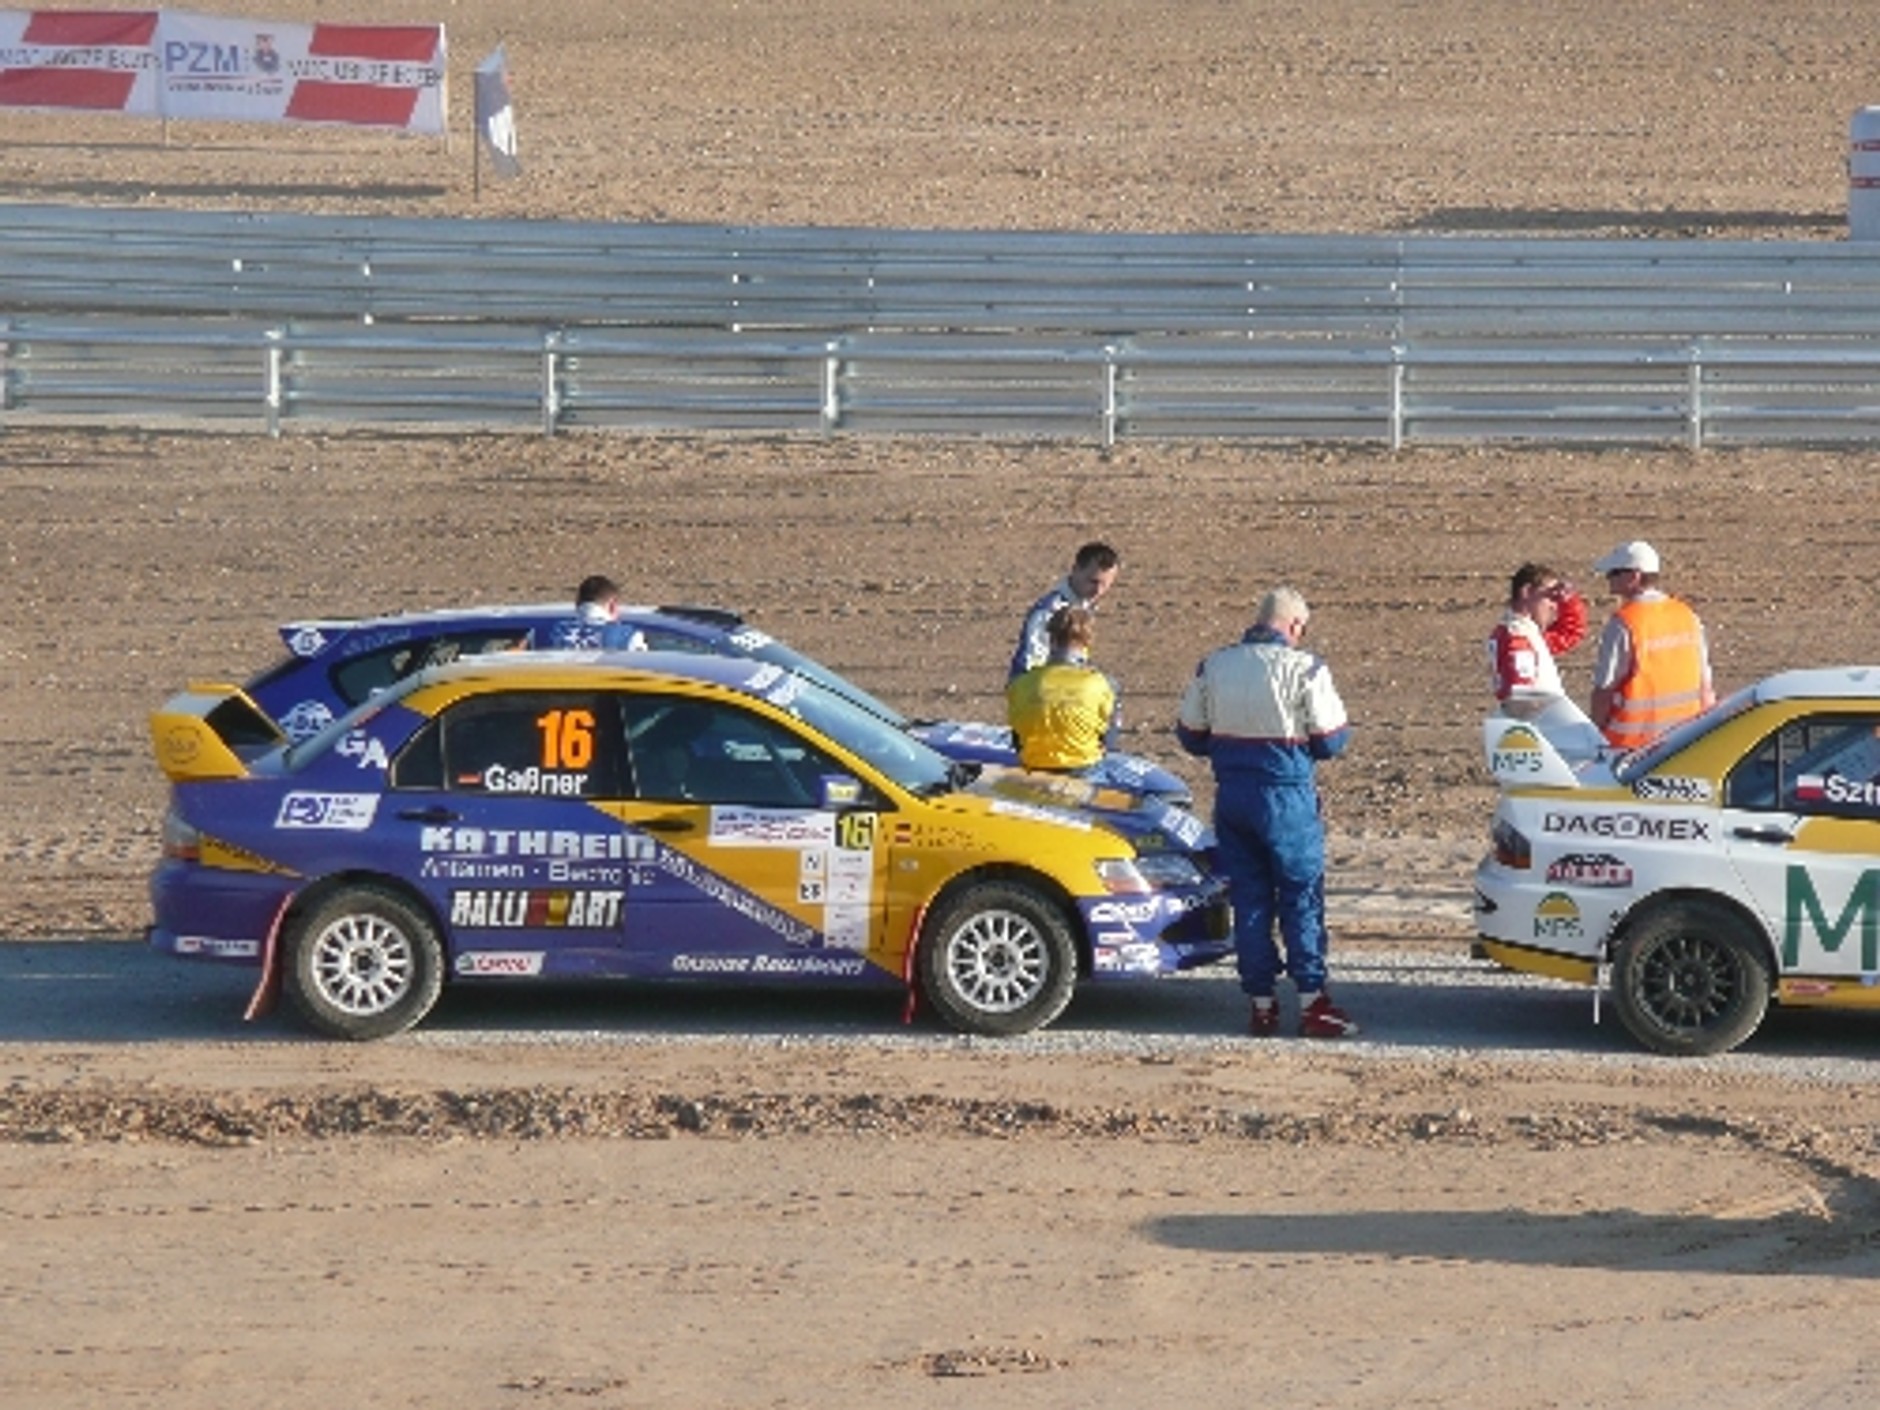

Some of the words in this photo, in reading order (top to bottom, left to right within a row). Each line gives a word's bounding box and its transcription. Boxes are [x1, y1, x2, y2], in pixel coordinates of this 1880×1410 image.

[165, 41, 239, 73] PZM
[537, 710, 595, 768] 16
[1492, 752, 1543, 773] MPS
[837, 812, 873, 850] 16
[1542, 812, 1710, 840] DAGOMEX
